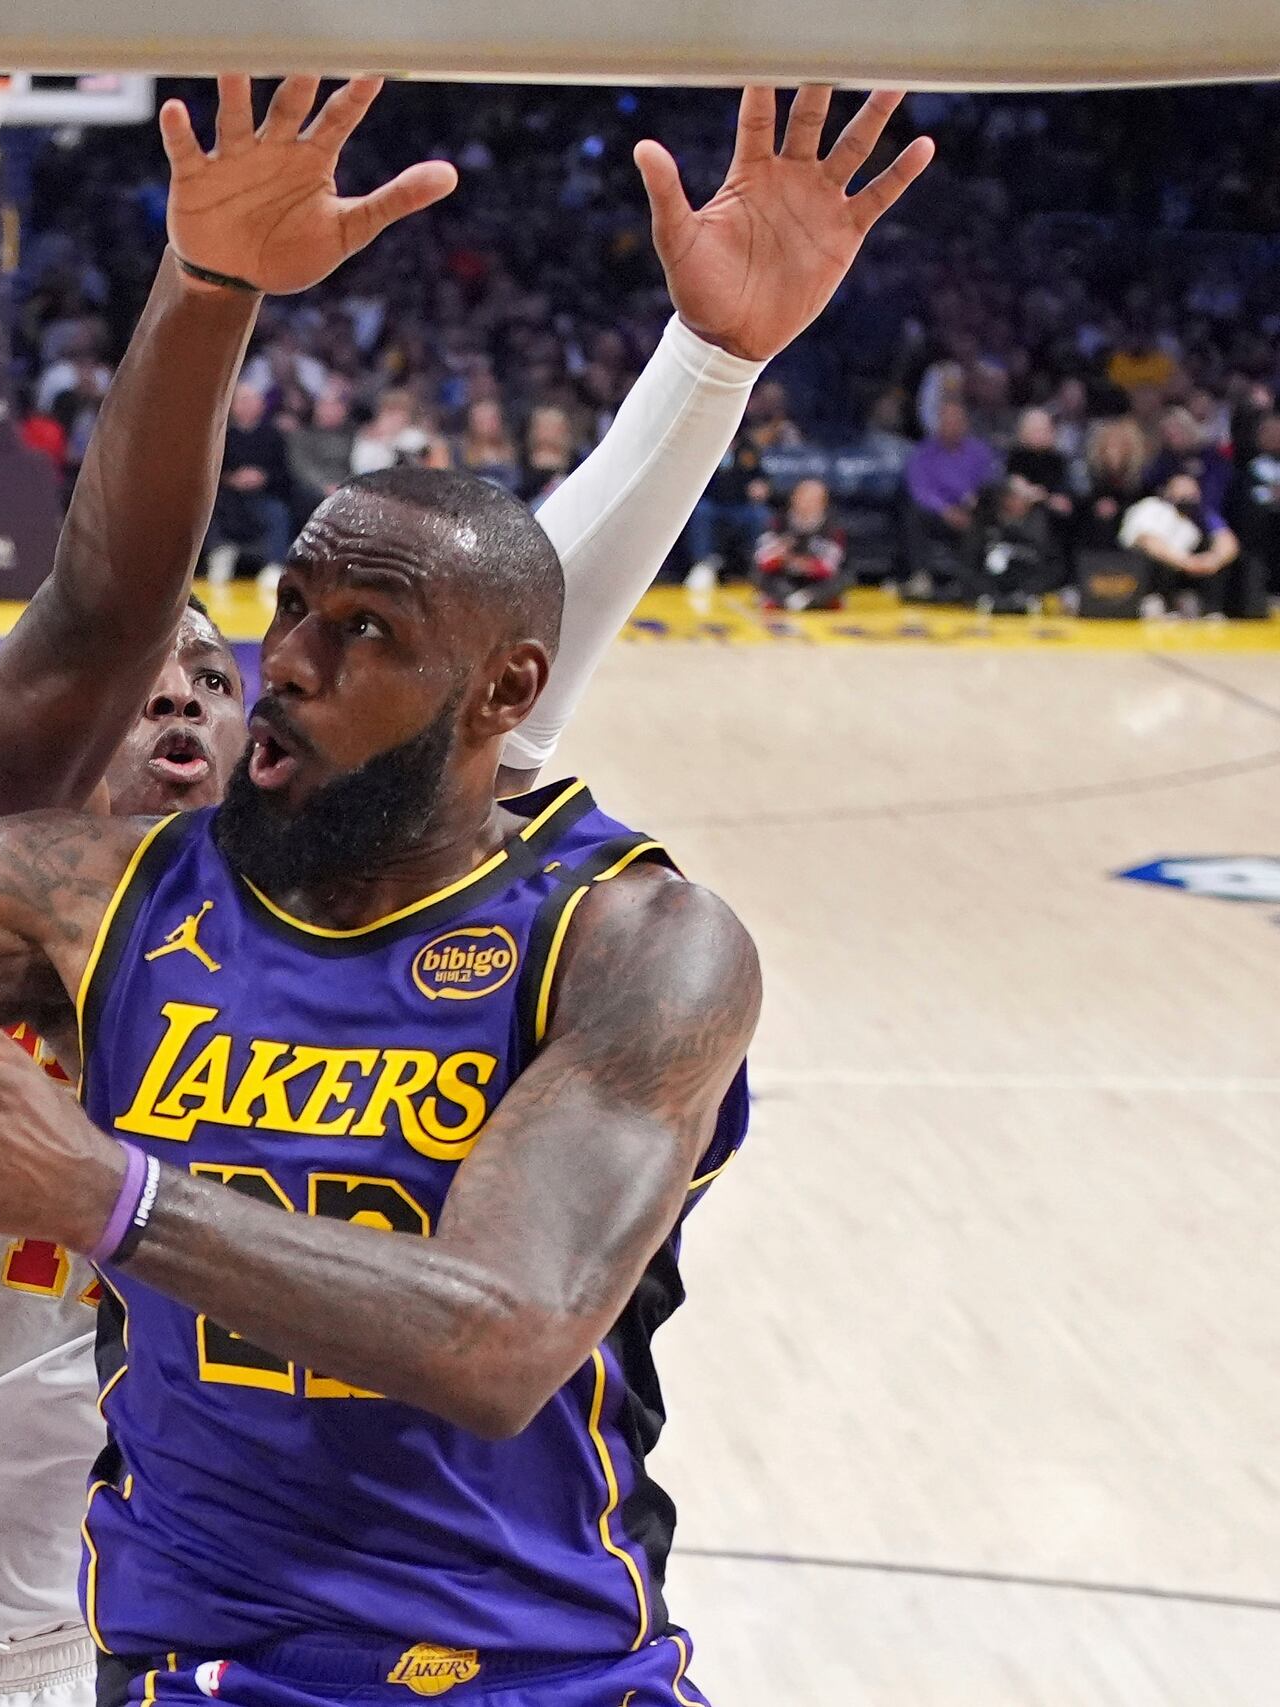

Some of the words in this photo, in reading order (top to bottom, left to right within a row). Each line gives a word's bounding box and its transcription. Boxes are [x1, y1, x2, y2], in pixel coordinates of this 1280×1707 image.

[423, 944, 511, 977] bibigo
[113, 1001, 498, 1161] LAKERS
[393, 1655, 472, 1681] LAKERS
